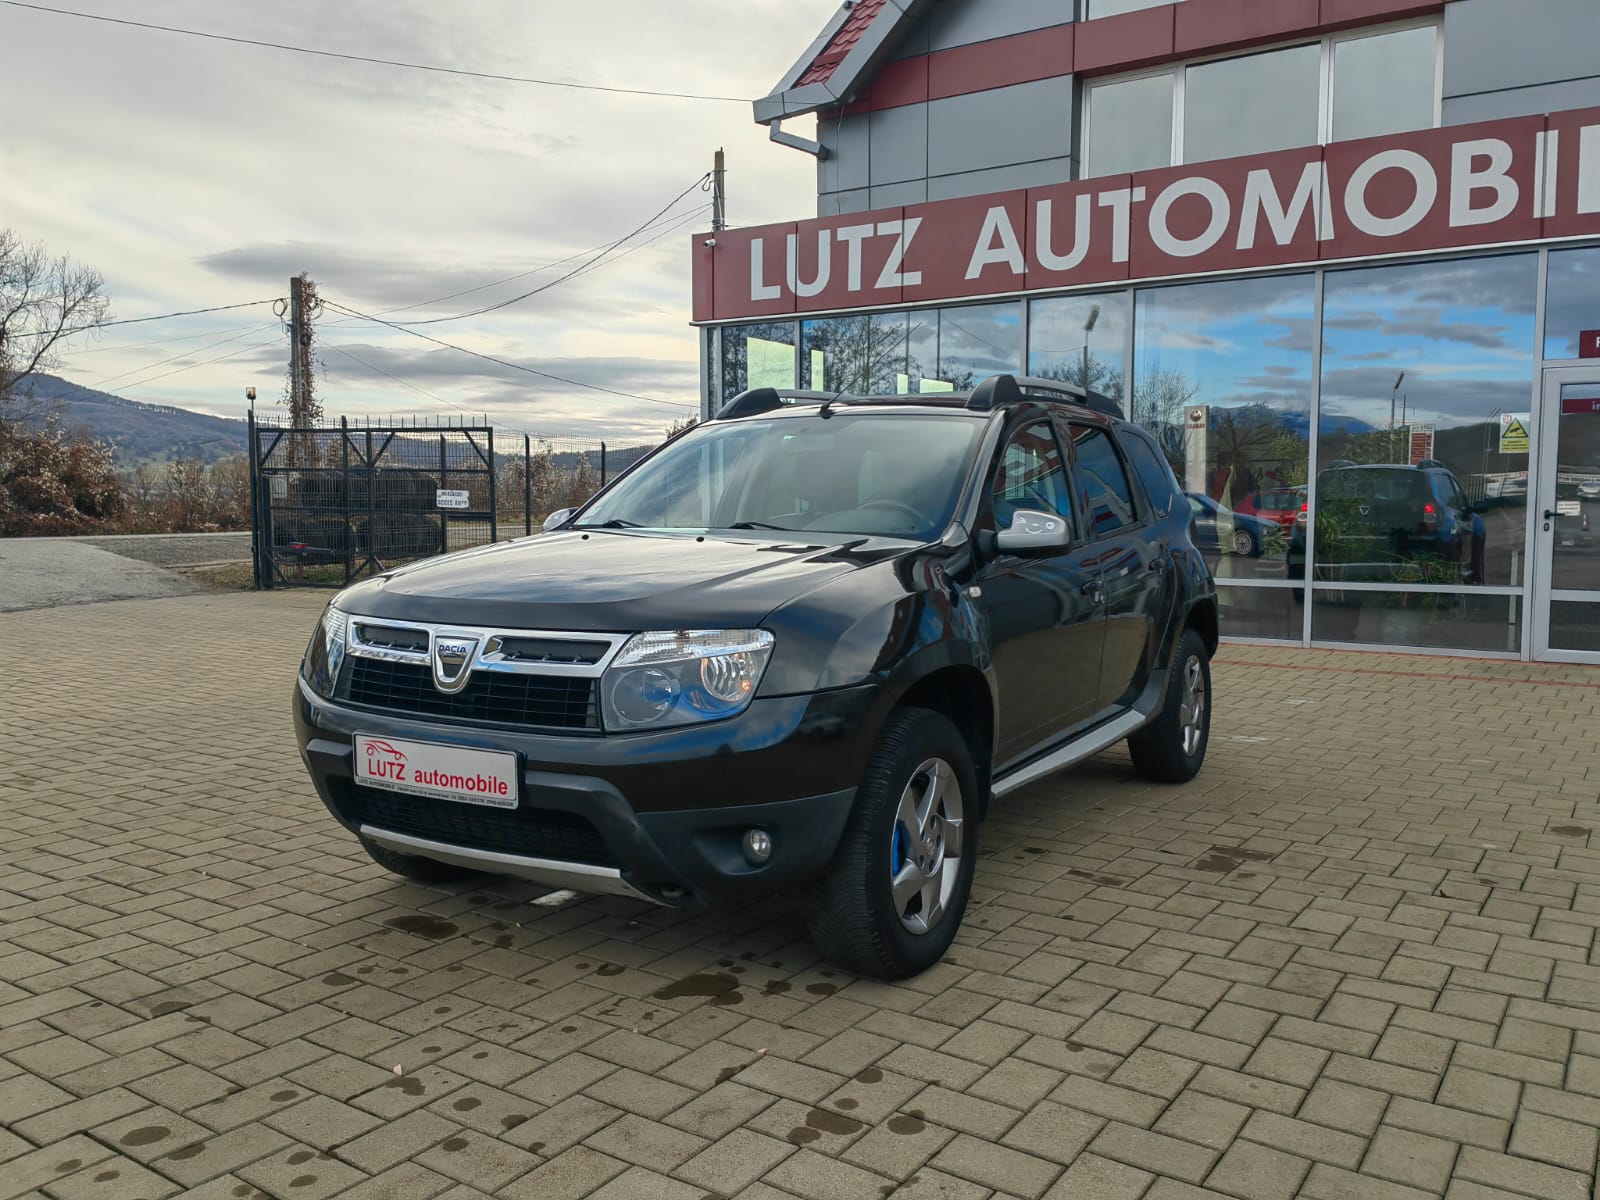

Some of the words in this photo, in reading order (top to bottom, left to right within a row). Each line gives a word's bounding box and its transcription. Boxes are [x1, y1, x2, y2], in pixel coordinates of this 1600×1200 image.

[751, 217, 923, 301] LUTZ
[438, 644, 467, 654] DACIA
[368, 758, 406, 781] LUTZ
[414, 769, 508, 795] automobile
